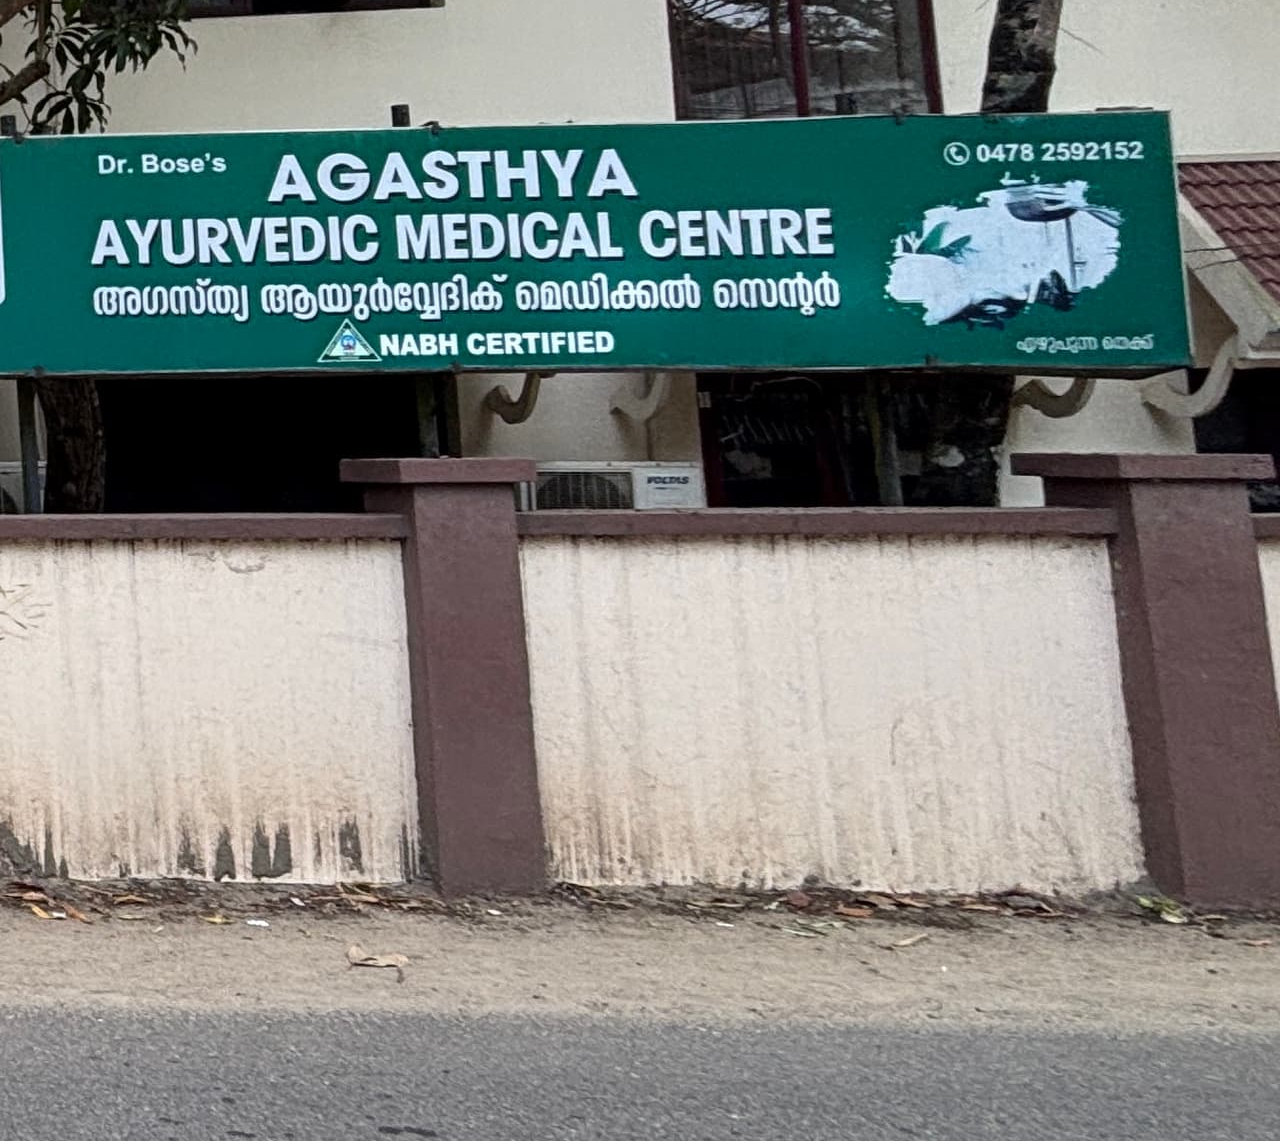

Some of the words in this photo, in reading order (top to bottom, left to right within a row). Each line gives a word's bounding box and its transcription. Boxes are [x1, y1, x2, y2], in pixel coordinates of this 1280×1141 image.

[98, 154, 134, 175] Dr.
[142, 152, 227, 173] Bose's
[976, 143, 1035, 163] 0478
[1041, 140, 1145, 162] 2592152
[267, 148, 638, 203] AGASTHYA
[91, 214, 379, 265] AYURVEDIC
[395, 211, 624, 260] MEDICAL
[640, 207, 835, 258] CENTRE
[93, 278, 249, 322] അഗസ്ത്യ
[516, 272, 701, 311] മെഡിക്കൽ
[379, 333, 458, 356] NABH
[466, 331, 615, 355] CERTIFIED
[646, 476, 689, 485] VOLTAS
